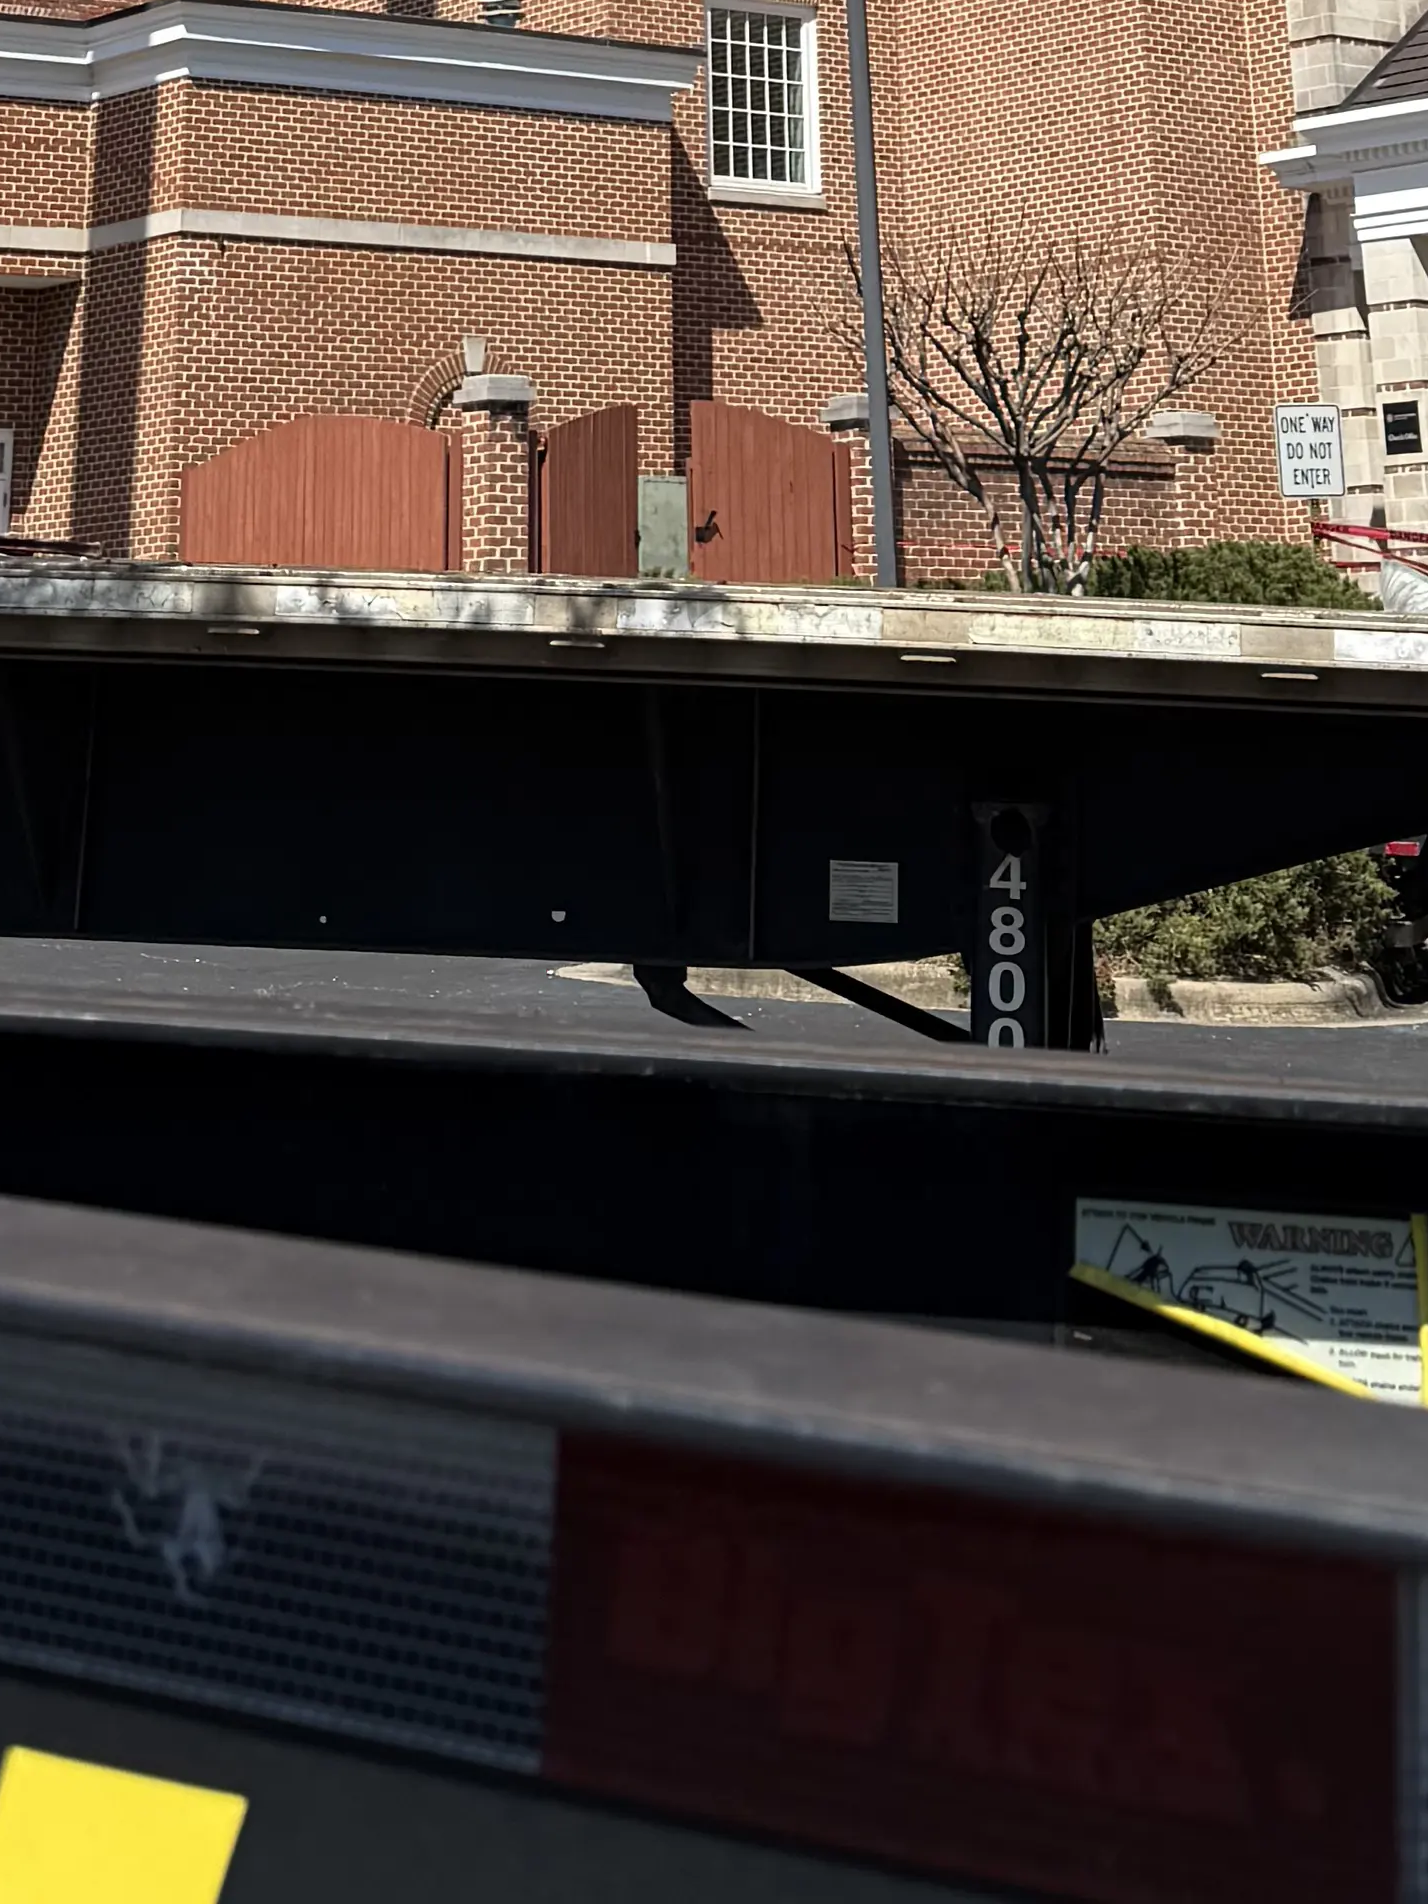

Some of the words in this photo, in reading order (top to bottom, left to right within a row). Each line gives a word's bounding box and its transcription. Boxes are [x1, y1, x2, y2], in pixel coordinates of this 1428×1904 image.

[1280, 416, 1307, 434] ONE
[1311, 416, 1335, 434] WAY
[1286, 442, 1304, 460] DO
[1309, 442, 1333, 459] NOT
[1293, 468, 1332, 486] ENTER
[1227, 1220, 1394, 1259] WARNING
